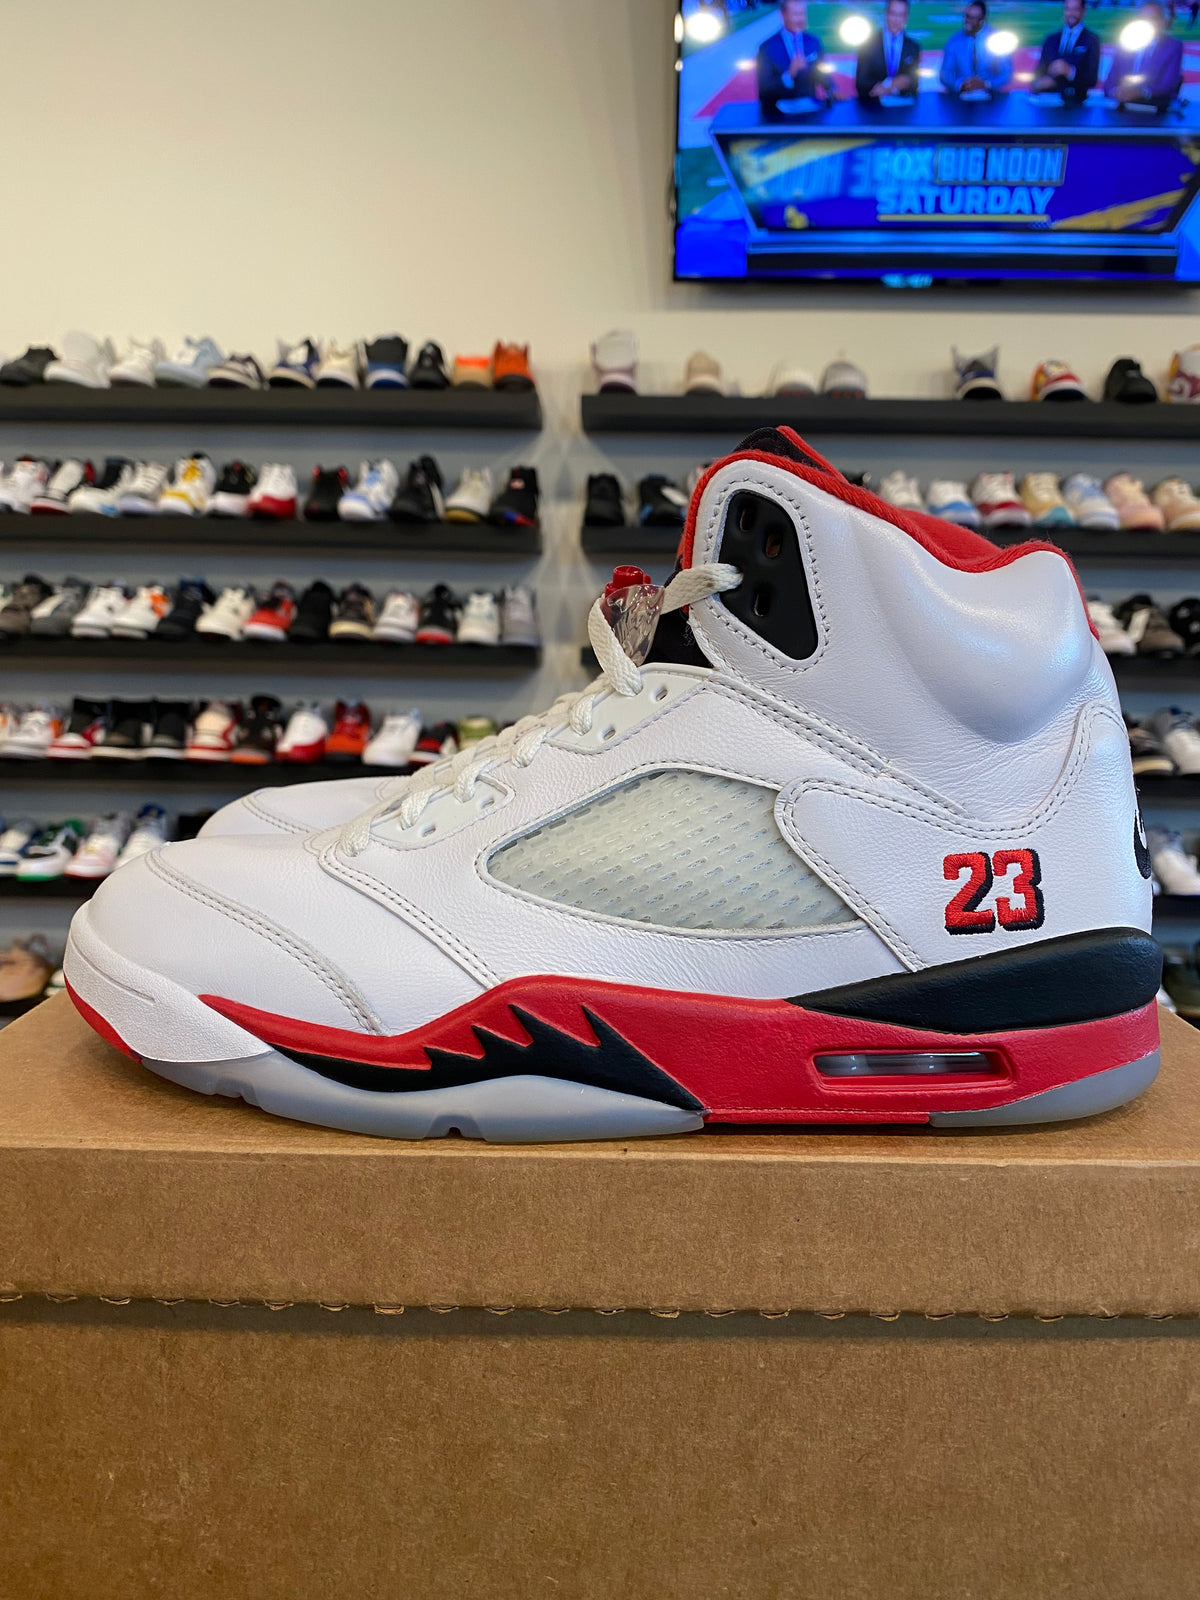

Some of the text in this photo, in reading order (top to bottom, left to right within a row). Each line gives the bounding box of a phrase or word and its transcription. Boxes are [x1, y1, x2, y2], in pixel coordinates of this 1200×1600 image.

[873, 147, 933, 181] FOX
[938, 147, 985, 182] BIG
[986, 147, 1063, 182] NOON
[876, 185, 1055, 215] SATURDAY
[943, 848, 1045, 935] 23
